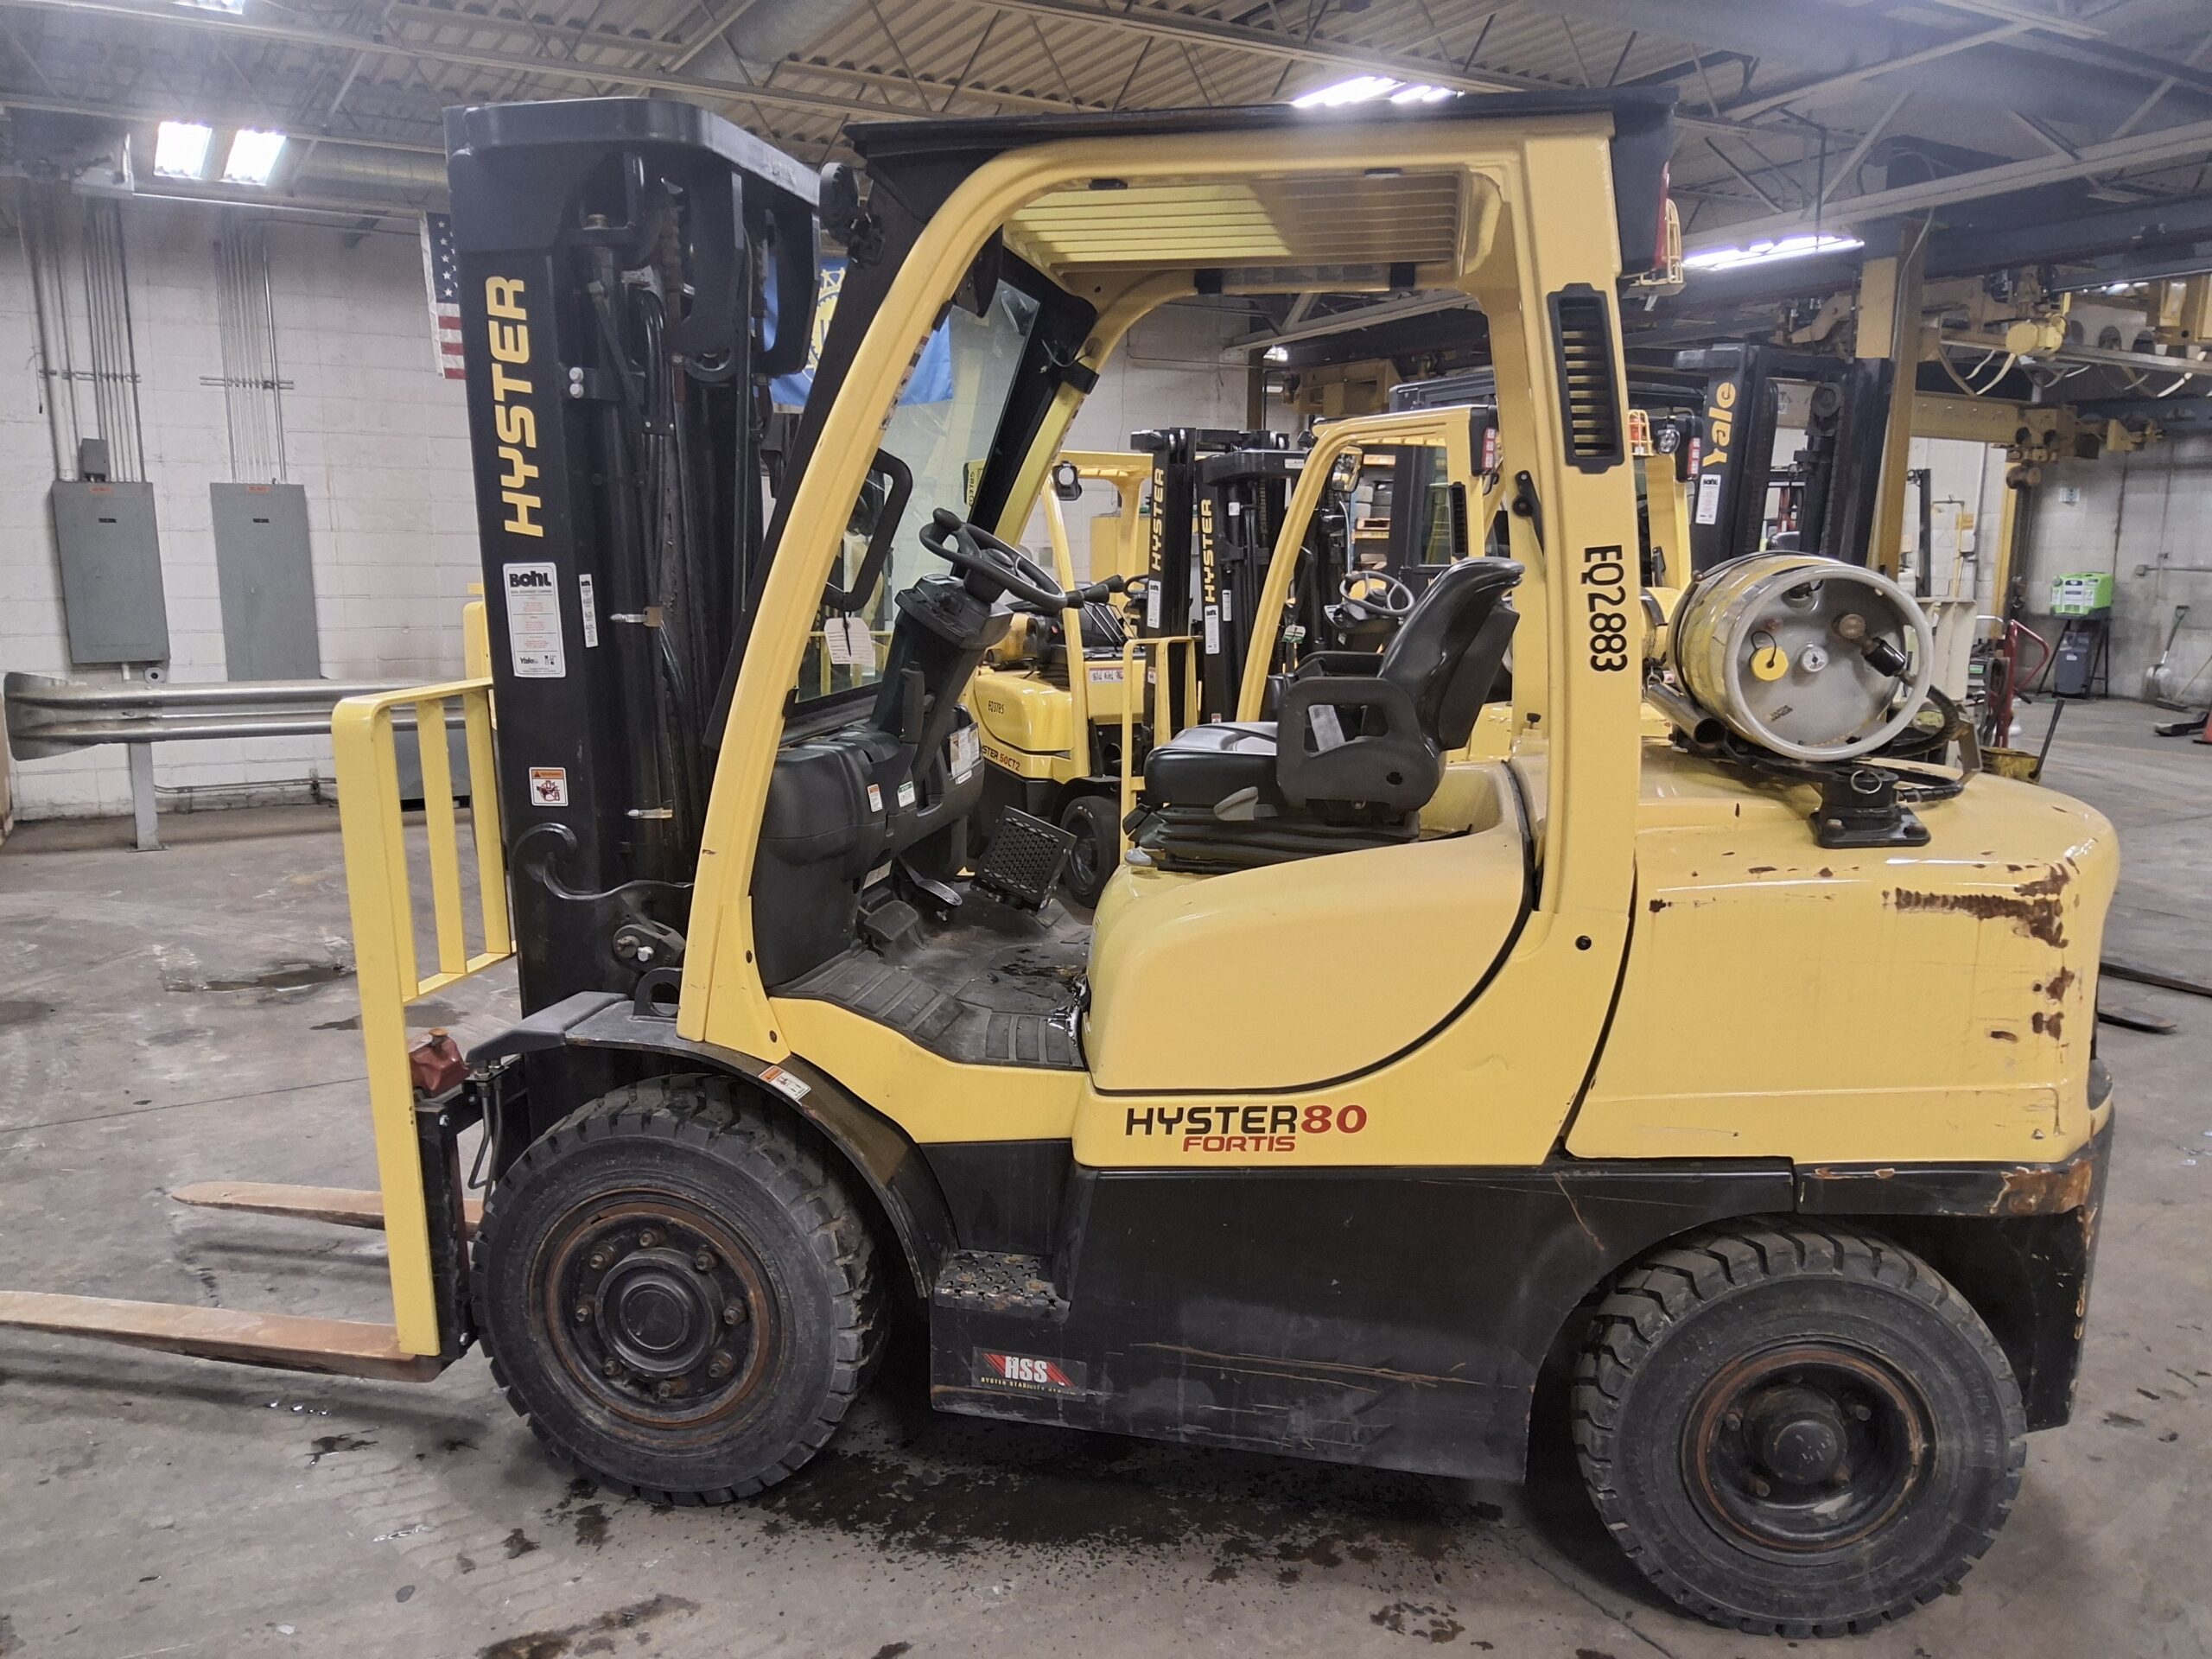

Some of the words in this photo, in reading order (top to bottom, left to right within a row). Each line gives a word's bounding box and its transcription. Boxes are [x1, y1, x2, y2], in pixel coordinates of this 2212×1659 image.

[485, 276, 543, 537] HYSTER
[1702, 382, 1736, 467] Yale
[1151, 467, 1164, 571] HYSTER
[1200, 499, 1216, 602] HYSTER
[1580, 545, 1628, 671] EQ2883
[1125, 1105, 1298, 1135] HYSTER
[1183, 1136, 1296, 1152] FORTIS
[1004, 1356, 1047, 1382] HSS
